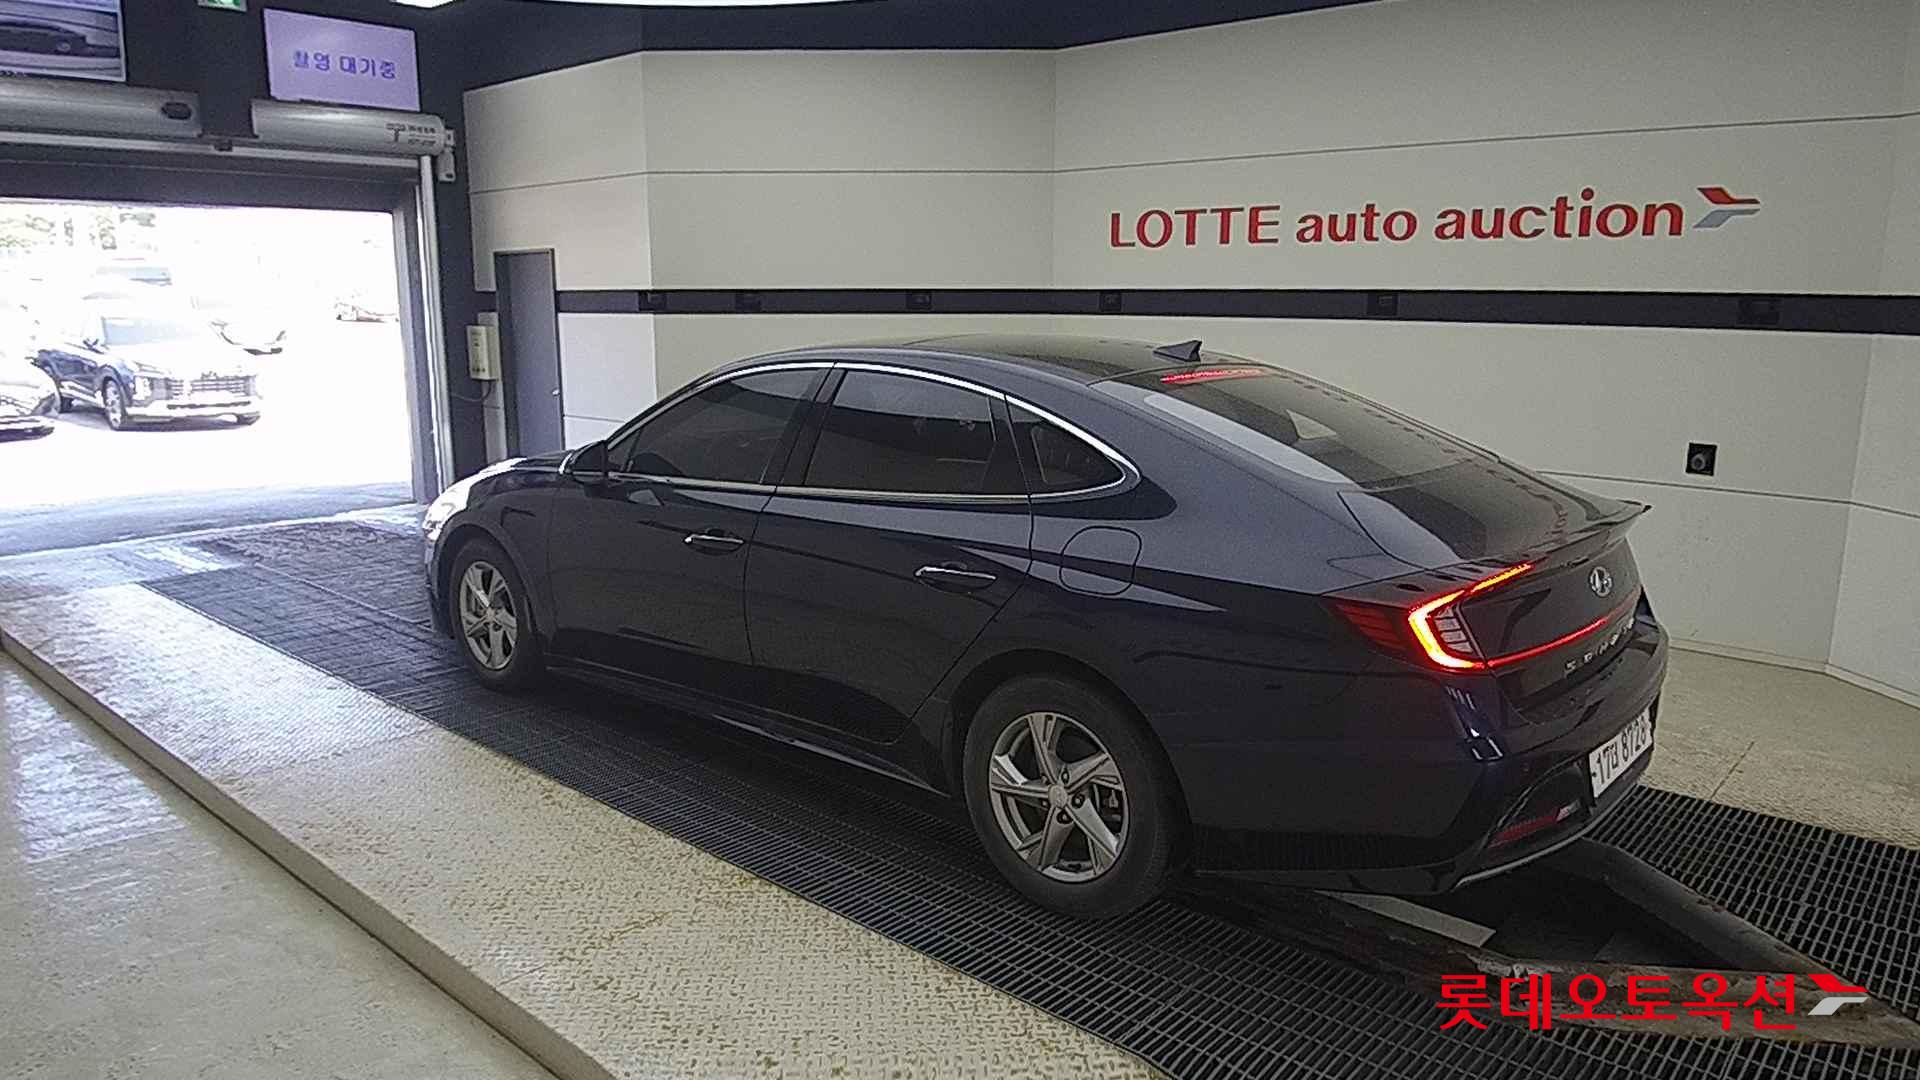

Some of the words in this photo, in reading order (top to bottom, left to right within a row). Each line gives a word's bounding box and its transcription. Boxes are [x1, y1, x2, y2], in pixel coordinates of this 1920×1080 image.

[1110, 205, 1280, 248] LOTTE
[1296, 203, 1418, 244] auto
[1434, 187, 1685, 241] auction
[1621, 715, 1647, 762] 8728
